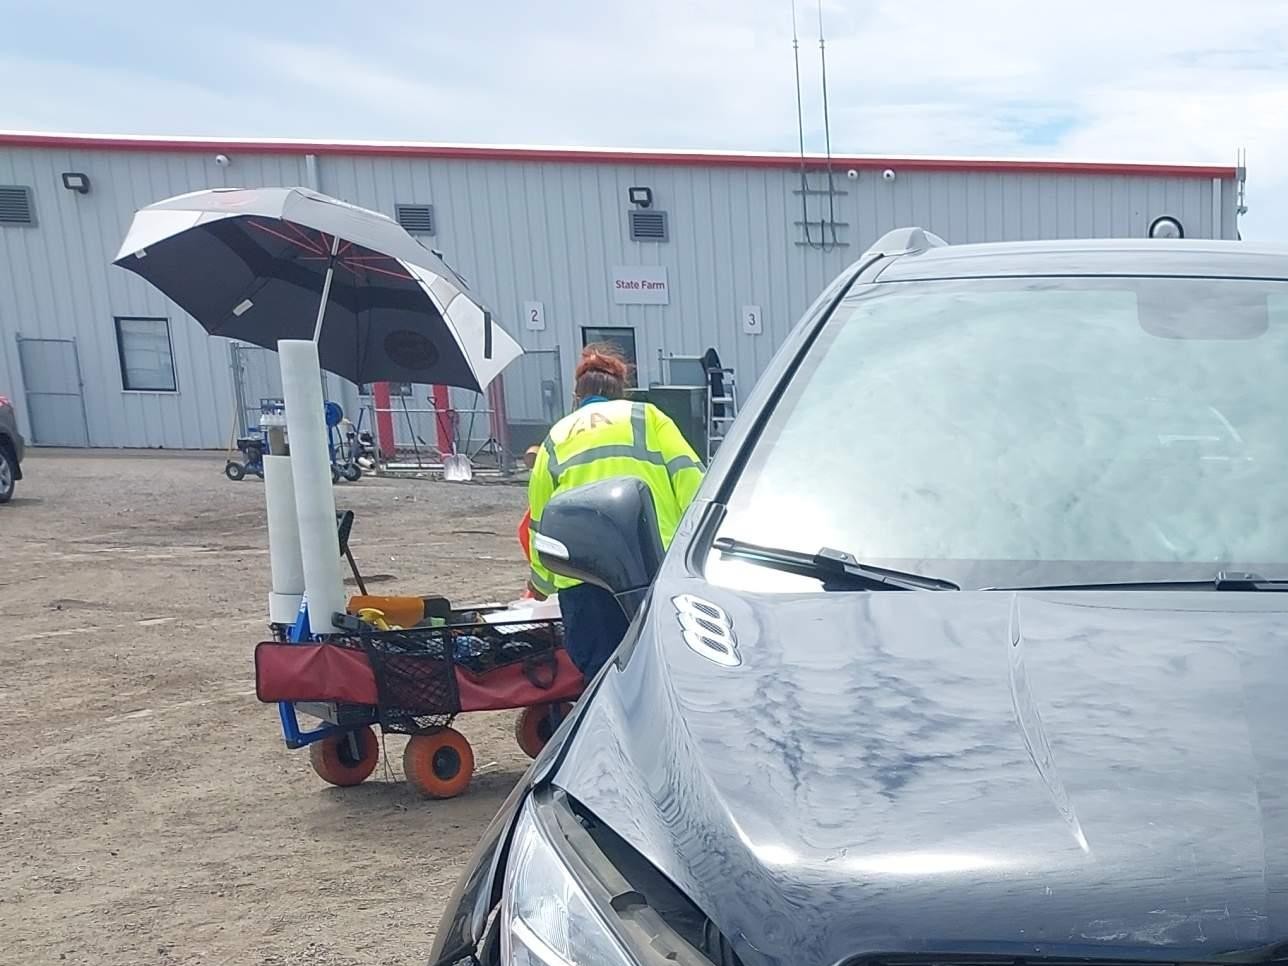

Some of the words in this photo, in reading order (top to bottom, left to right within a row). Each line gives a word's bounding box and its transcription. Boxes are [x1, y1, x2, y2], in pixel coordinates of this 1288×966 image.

[616, 280, 640, 290] State
[641, 280, 665, 290] Farm
[531, 309, 539, 322] 2
[748, 313, 756, 326] 3
